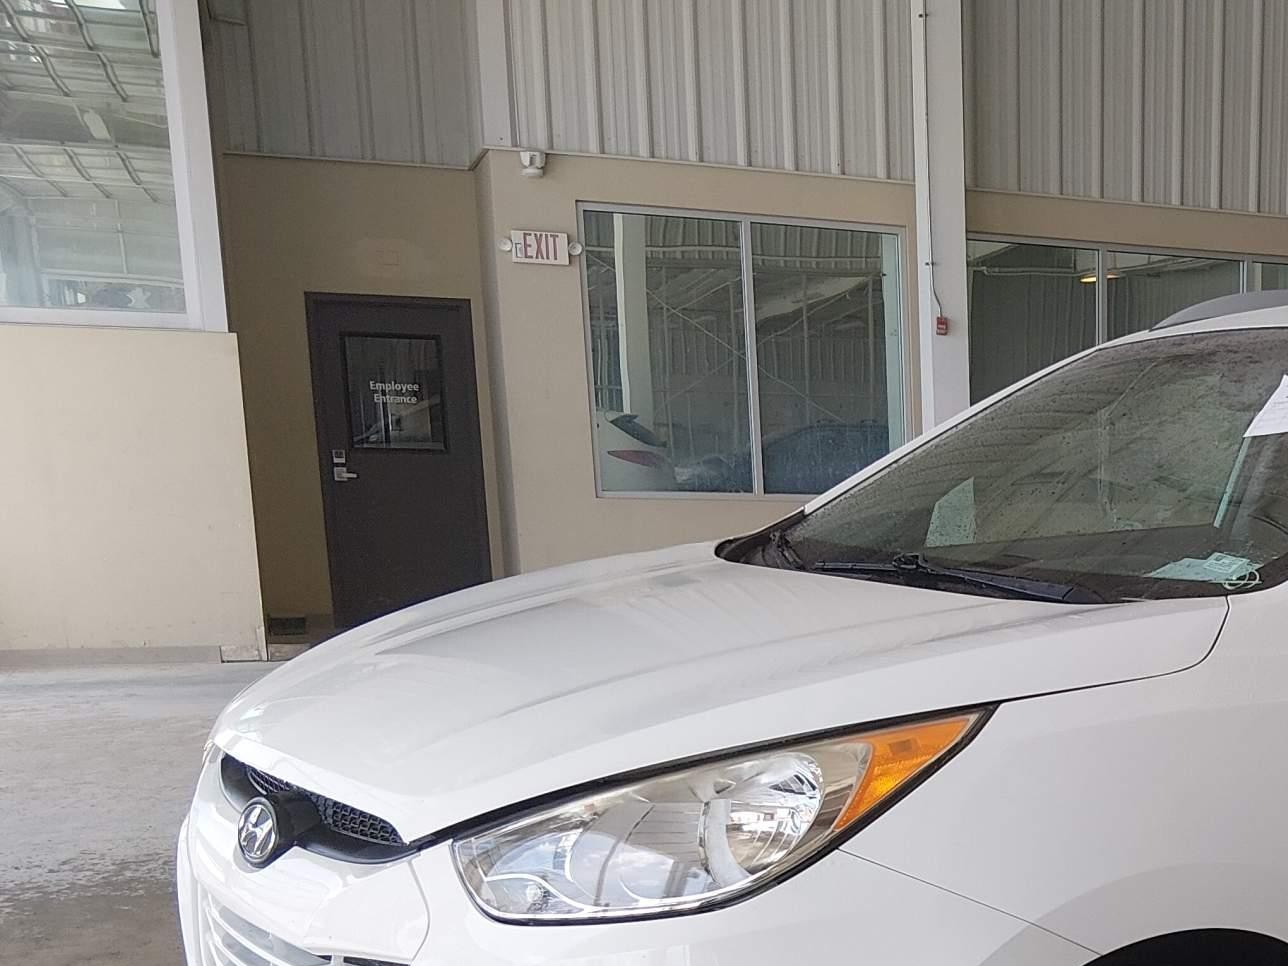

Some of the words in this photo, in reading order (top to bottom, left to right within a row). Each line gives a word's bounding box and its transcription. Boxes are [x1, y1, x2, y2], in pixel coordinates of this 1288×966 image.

[523, 232, 559, 260] EXIT
[369, 380, 420, 393] Employee
[374, 393, 418, 404] Entrance
